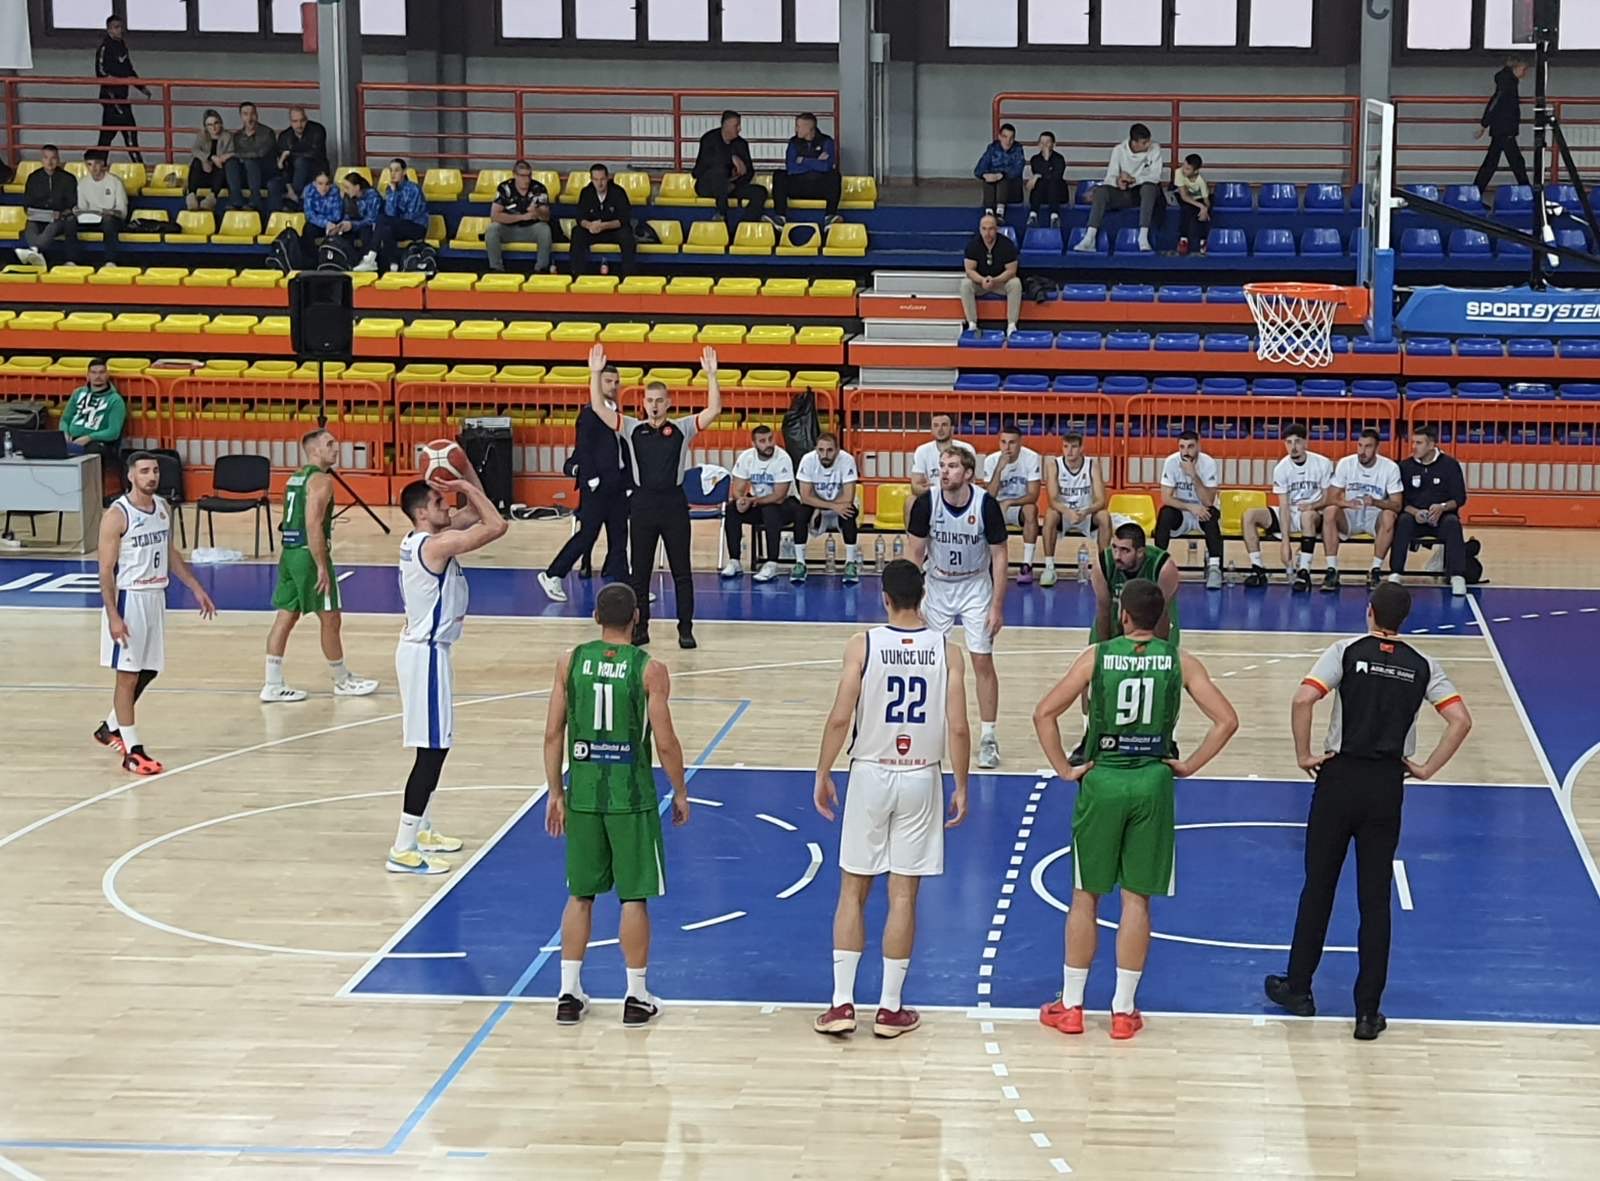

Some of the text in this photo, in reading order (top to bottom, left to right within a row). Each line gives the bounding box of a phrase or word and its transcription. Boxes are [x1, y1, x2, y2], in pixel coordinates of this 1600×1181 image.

[286, 491, 296, 523] 7
[153, 551, 161, 569] 6
[949, 550, 962, 566] 21
[881, 647, 936, 666] VUKČEVIĆ
[592, 682, 614, 731] 11
[885, 675, 928, 724] 22
[1115, 677, 1155, 726] 91
